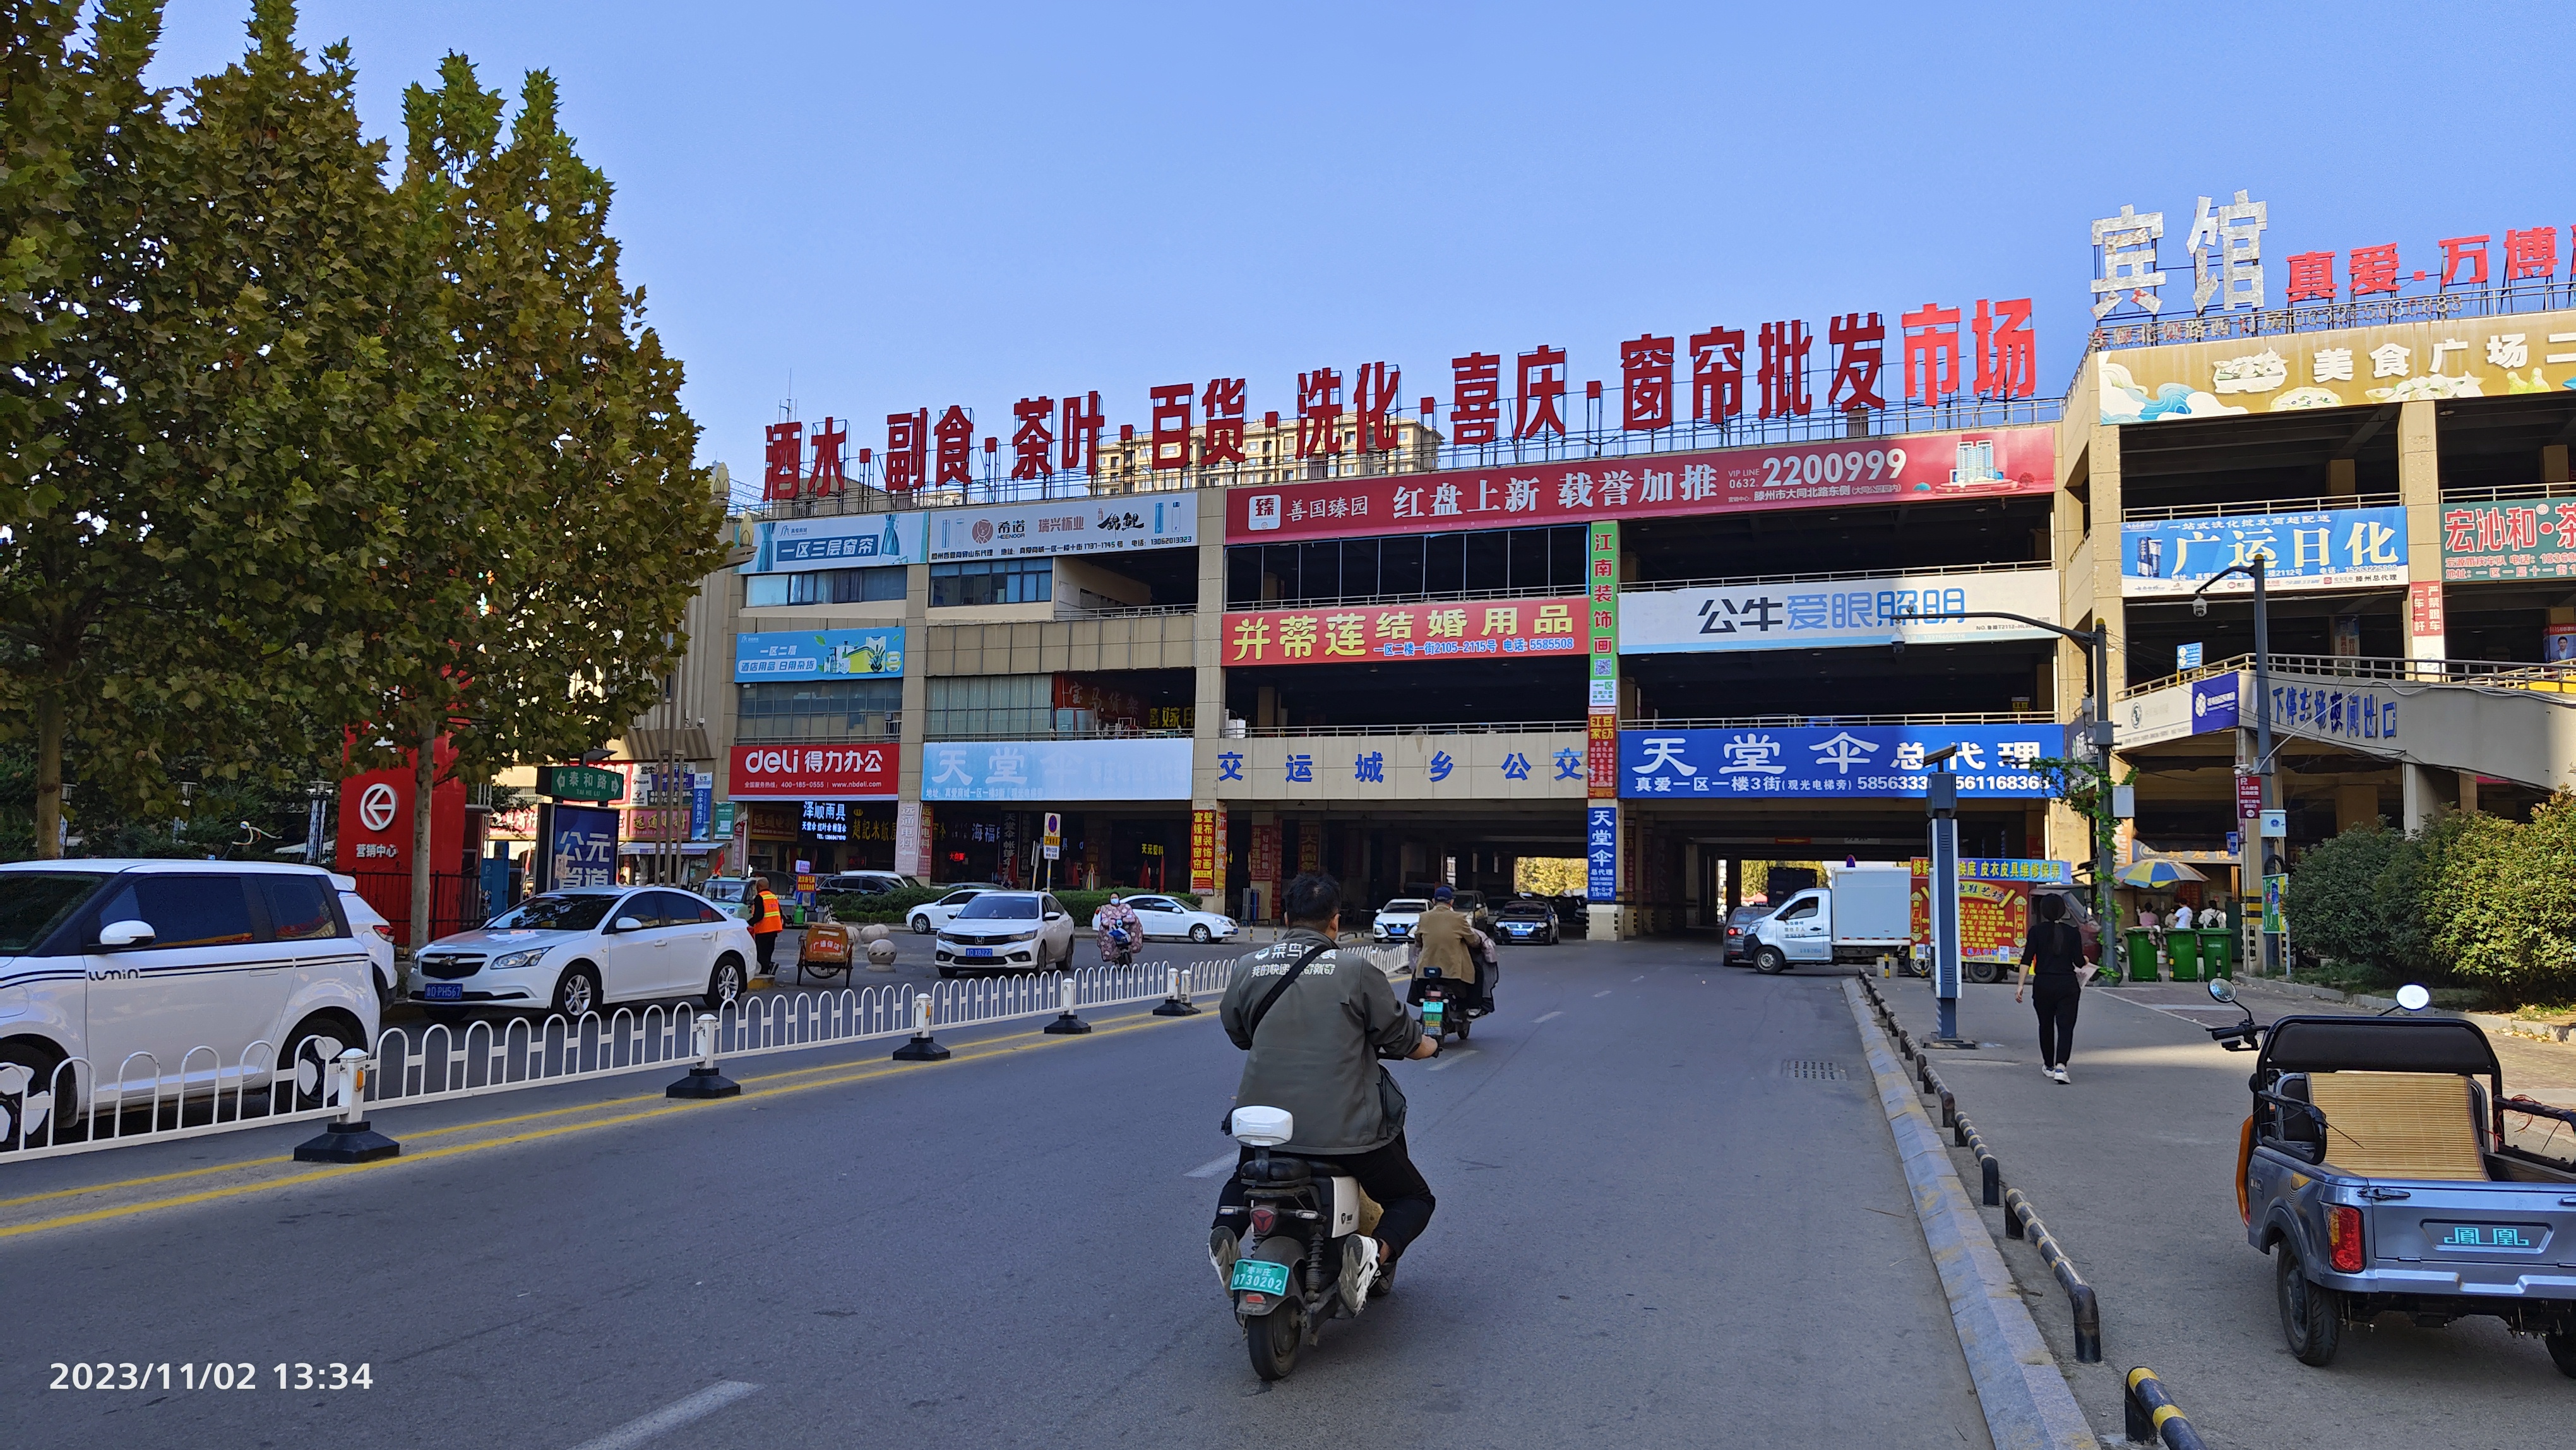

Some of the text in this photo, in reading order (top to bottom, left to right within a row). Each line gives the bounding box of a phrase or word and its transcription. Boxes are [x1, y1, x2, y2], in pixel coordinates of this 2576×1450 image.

[2090, 189, 2268, 320] 宾馆
[1729, 478, 1756, 488] 0632
[1762, 448, 1907, 488] 2200999
[1285, 494, 1369, 522] 善国臻园
[1392, 477, 1541, 519] 红盘上新
[1558, 463, 1718, 508] 载誉加推
[1038, 515, 1085, 533] 瑞兴杯业
[780, 537, 874, 558] 一区三层窗帘
[1150, 536, 1192, 546] 13062013323
[2173, 521, 2399, 576] 广运日化
[1593, 533, 1614, 654] 江南装饰画
[2427, 585, 2442, 632] 严禁跟车
[1232, 604, 1574, 662] 并蒂莲结婚用品
[1529, 637, 1575, 652] 5585508
[740, 660, 815, 672] 酒店用品 日用杂货
[745, 749, 883, 774] deli 得力办公
[1217, 748, 1583, 784] 交运城乡公交
[1631, 731, 1880, 777] 天堂伞
[569, 771, 608, 790] 泰和路
[900, 806, 915, 849] 远通电料
[1590, 810, 1614, 868] 天堂伞
[356, 843, 399, 858] 营销中心
[559, 830, 611, 863] 公元
[1251, 963, 1336, 978] 我的快递寄就寄
[1233, 1273, 1283, 1291] 0730202
